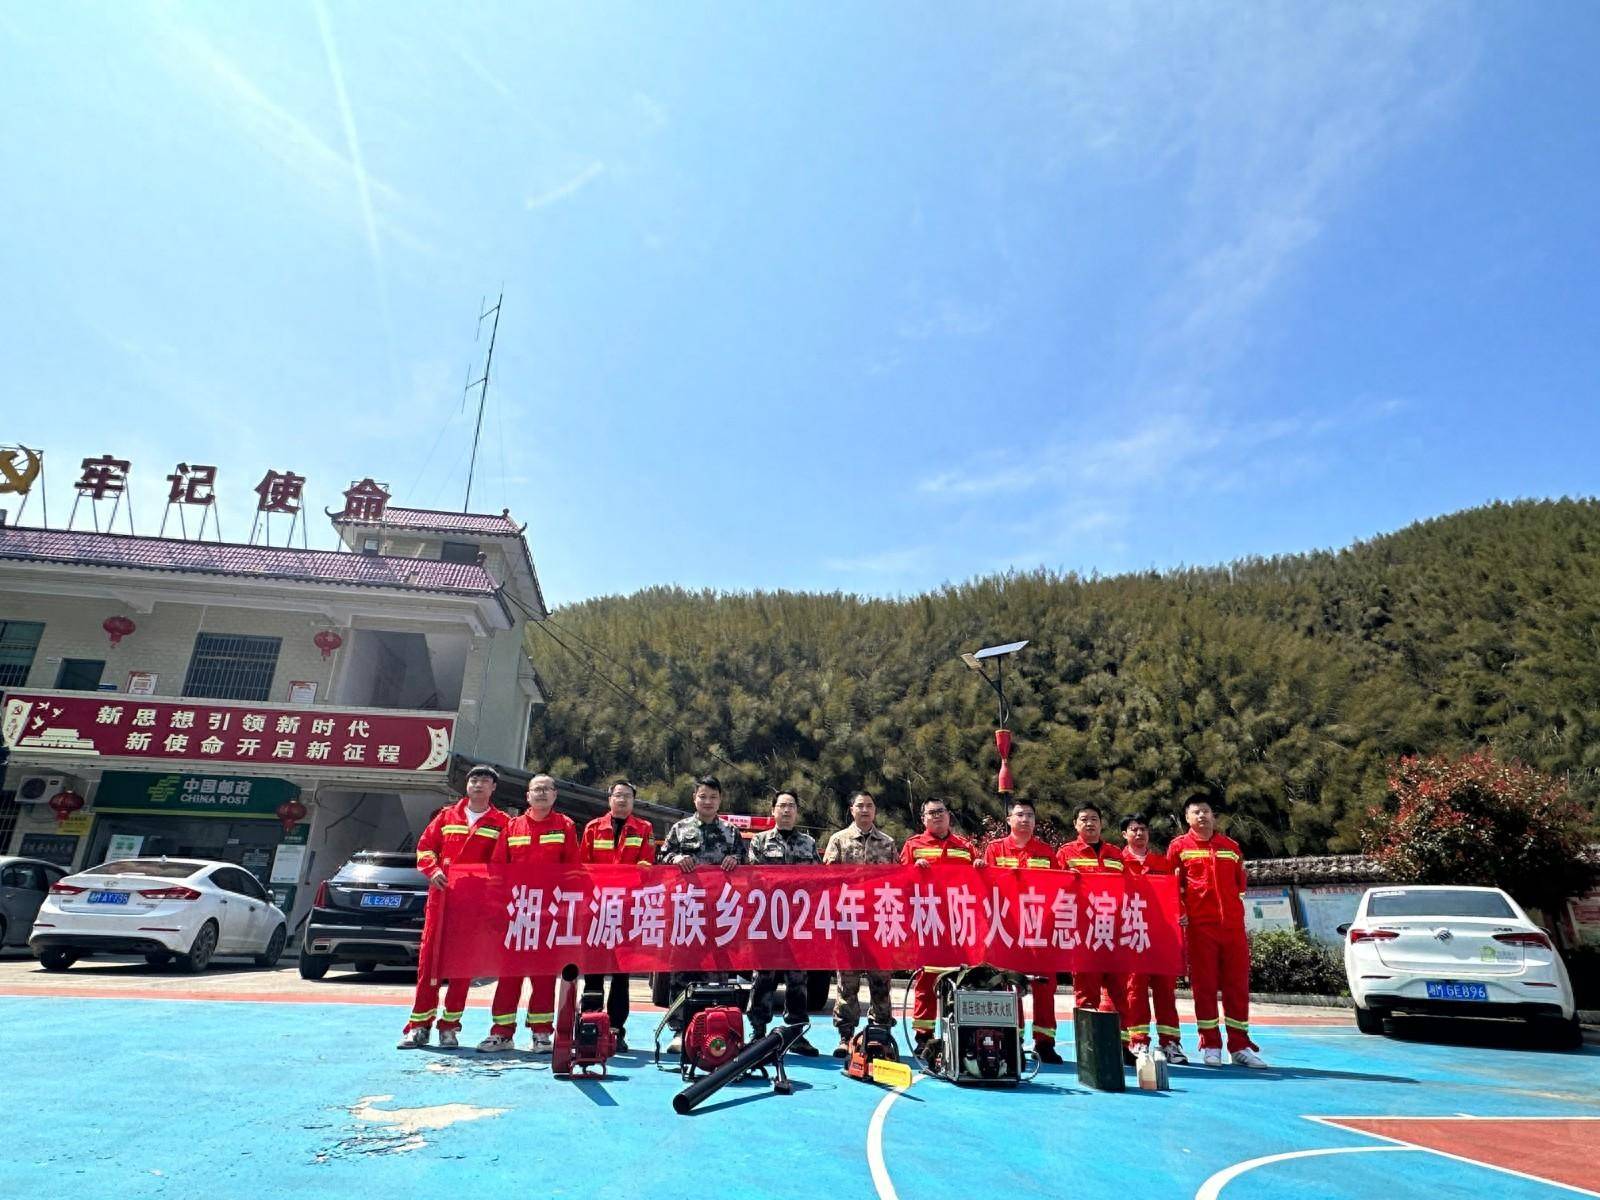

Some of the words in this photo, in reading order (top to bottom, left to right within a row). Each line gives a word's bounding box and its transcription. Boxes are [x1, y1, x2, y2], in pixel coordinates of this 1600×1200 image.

[75, 455, 391, 521] 牢记使命
[96, 705, 370, 738] 新思想引领新时代
[125, 731, 400, 763] 新使命开启新征程
[180, 794, 215, 804] CHINA
[219, 796, 249, 805] POST
[183, 778, 252, 795] 中国邮政
[504, 882, 1151, 953] 湘江源瑶族乡2024年森林防火应急演练
